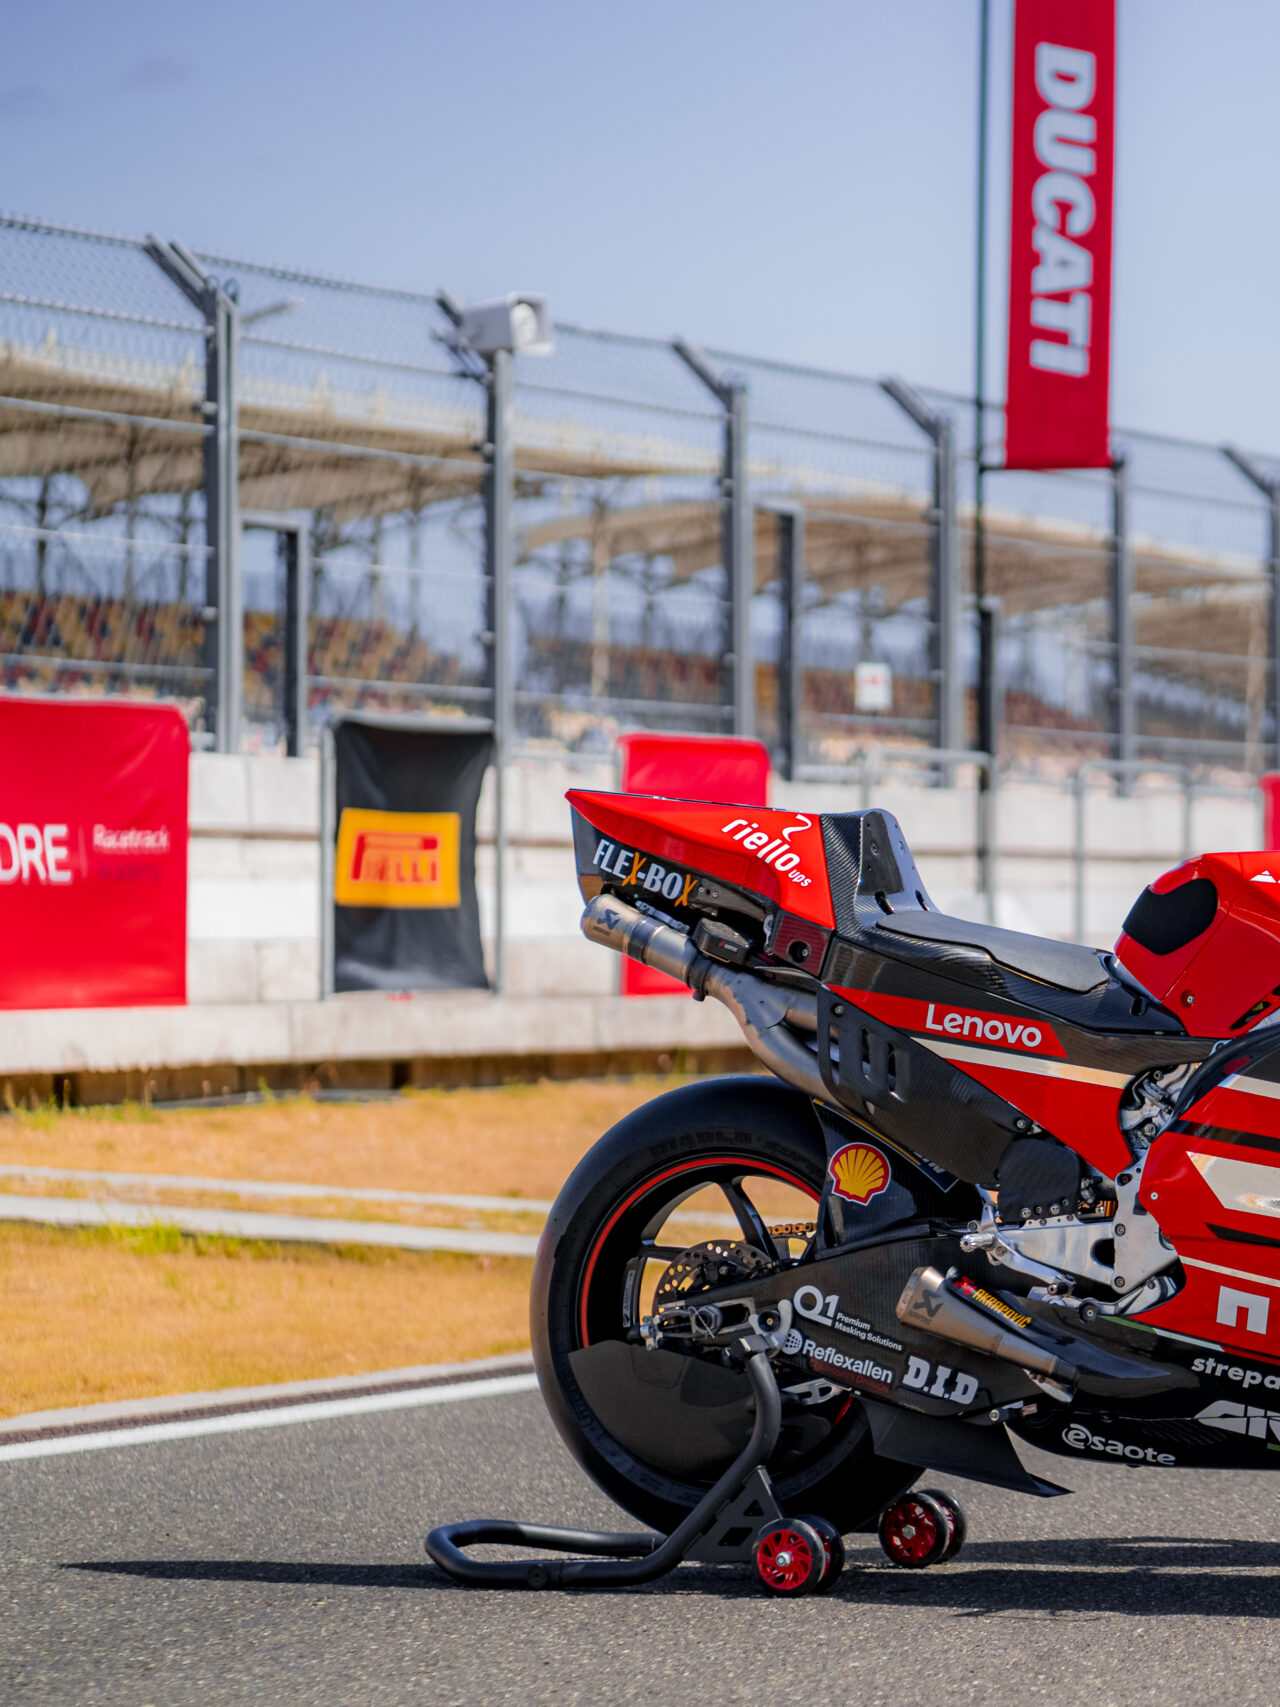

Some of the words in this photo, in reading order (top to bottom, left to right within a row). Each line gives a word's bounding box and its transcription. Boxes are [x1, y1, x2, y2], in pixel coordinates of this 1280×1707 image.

[1030, 41, 1096, 378] DUCATI
[93, 824, 170, 853] Racetrack
[721, 818, 801, 872] riello
[592, 838, 698, 907] FLEX-BOX
[787, 868, 812, 887] ups
[924, 1003, 1042, 1048] Lenovo
[793, 1285, 840, 1327] Q1
[836, 1312, 871, 1331] Premium
[834, 1321, 866, 1340] Masking
[867, 1333, 903, 1352] Solutions
[802, 1339, 893, 1384] Reflexallen
[902, 1355, 979, 1405] D.I.D
[1062, 1423, 1176, 1466] esaote
